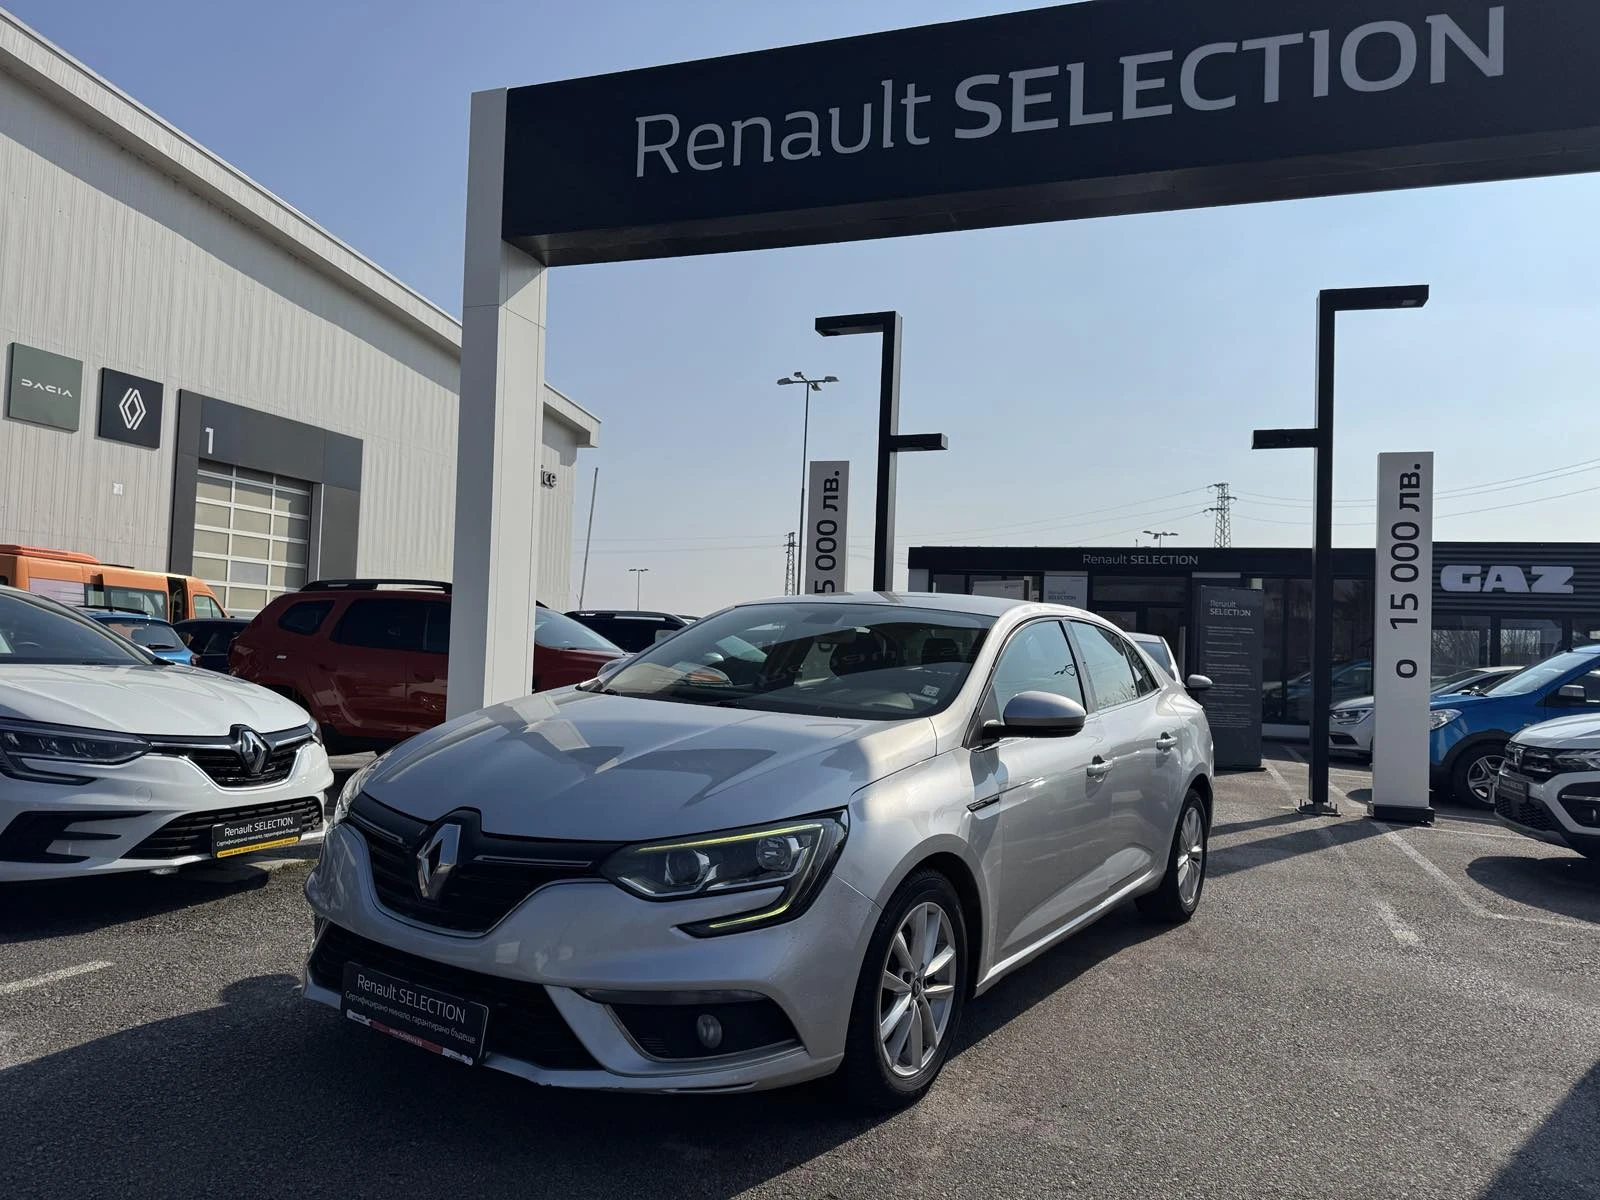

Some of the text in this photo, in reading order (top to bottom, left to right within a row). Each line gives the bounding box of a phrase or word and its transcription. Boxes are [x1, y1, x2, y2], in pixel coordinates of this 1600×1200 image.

[634, 6, 1505, 178] Renault SELECTION
[20, 379, 73, 398] DACIA
[205, 427, 214, 454] 1
[822, 470, 840, 512] лв.
[1399, 463, 1421, 513] лв.
[815, 519, 838, 571] 000
[1082, 554, 1199, 565] Renault SELECTION
[1390, 521, 1420, 583] 000
[1440, 565, 1574, 594] GAZ
[1209, 600, 1237, 608] Renault
[1209, 608, 1252, 617] SELECTION
[1389, 593, 1419, 630] 15
[224, 824, 253, 836] Renault
[254, 817, 294, 832] SELECTION
[345, 990, 389, 1012] Сертифицирано
[357, 973, 396, 1001] Renault
[399, 988, 466, 1024] SELECTION
